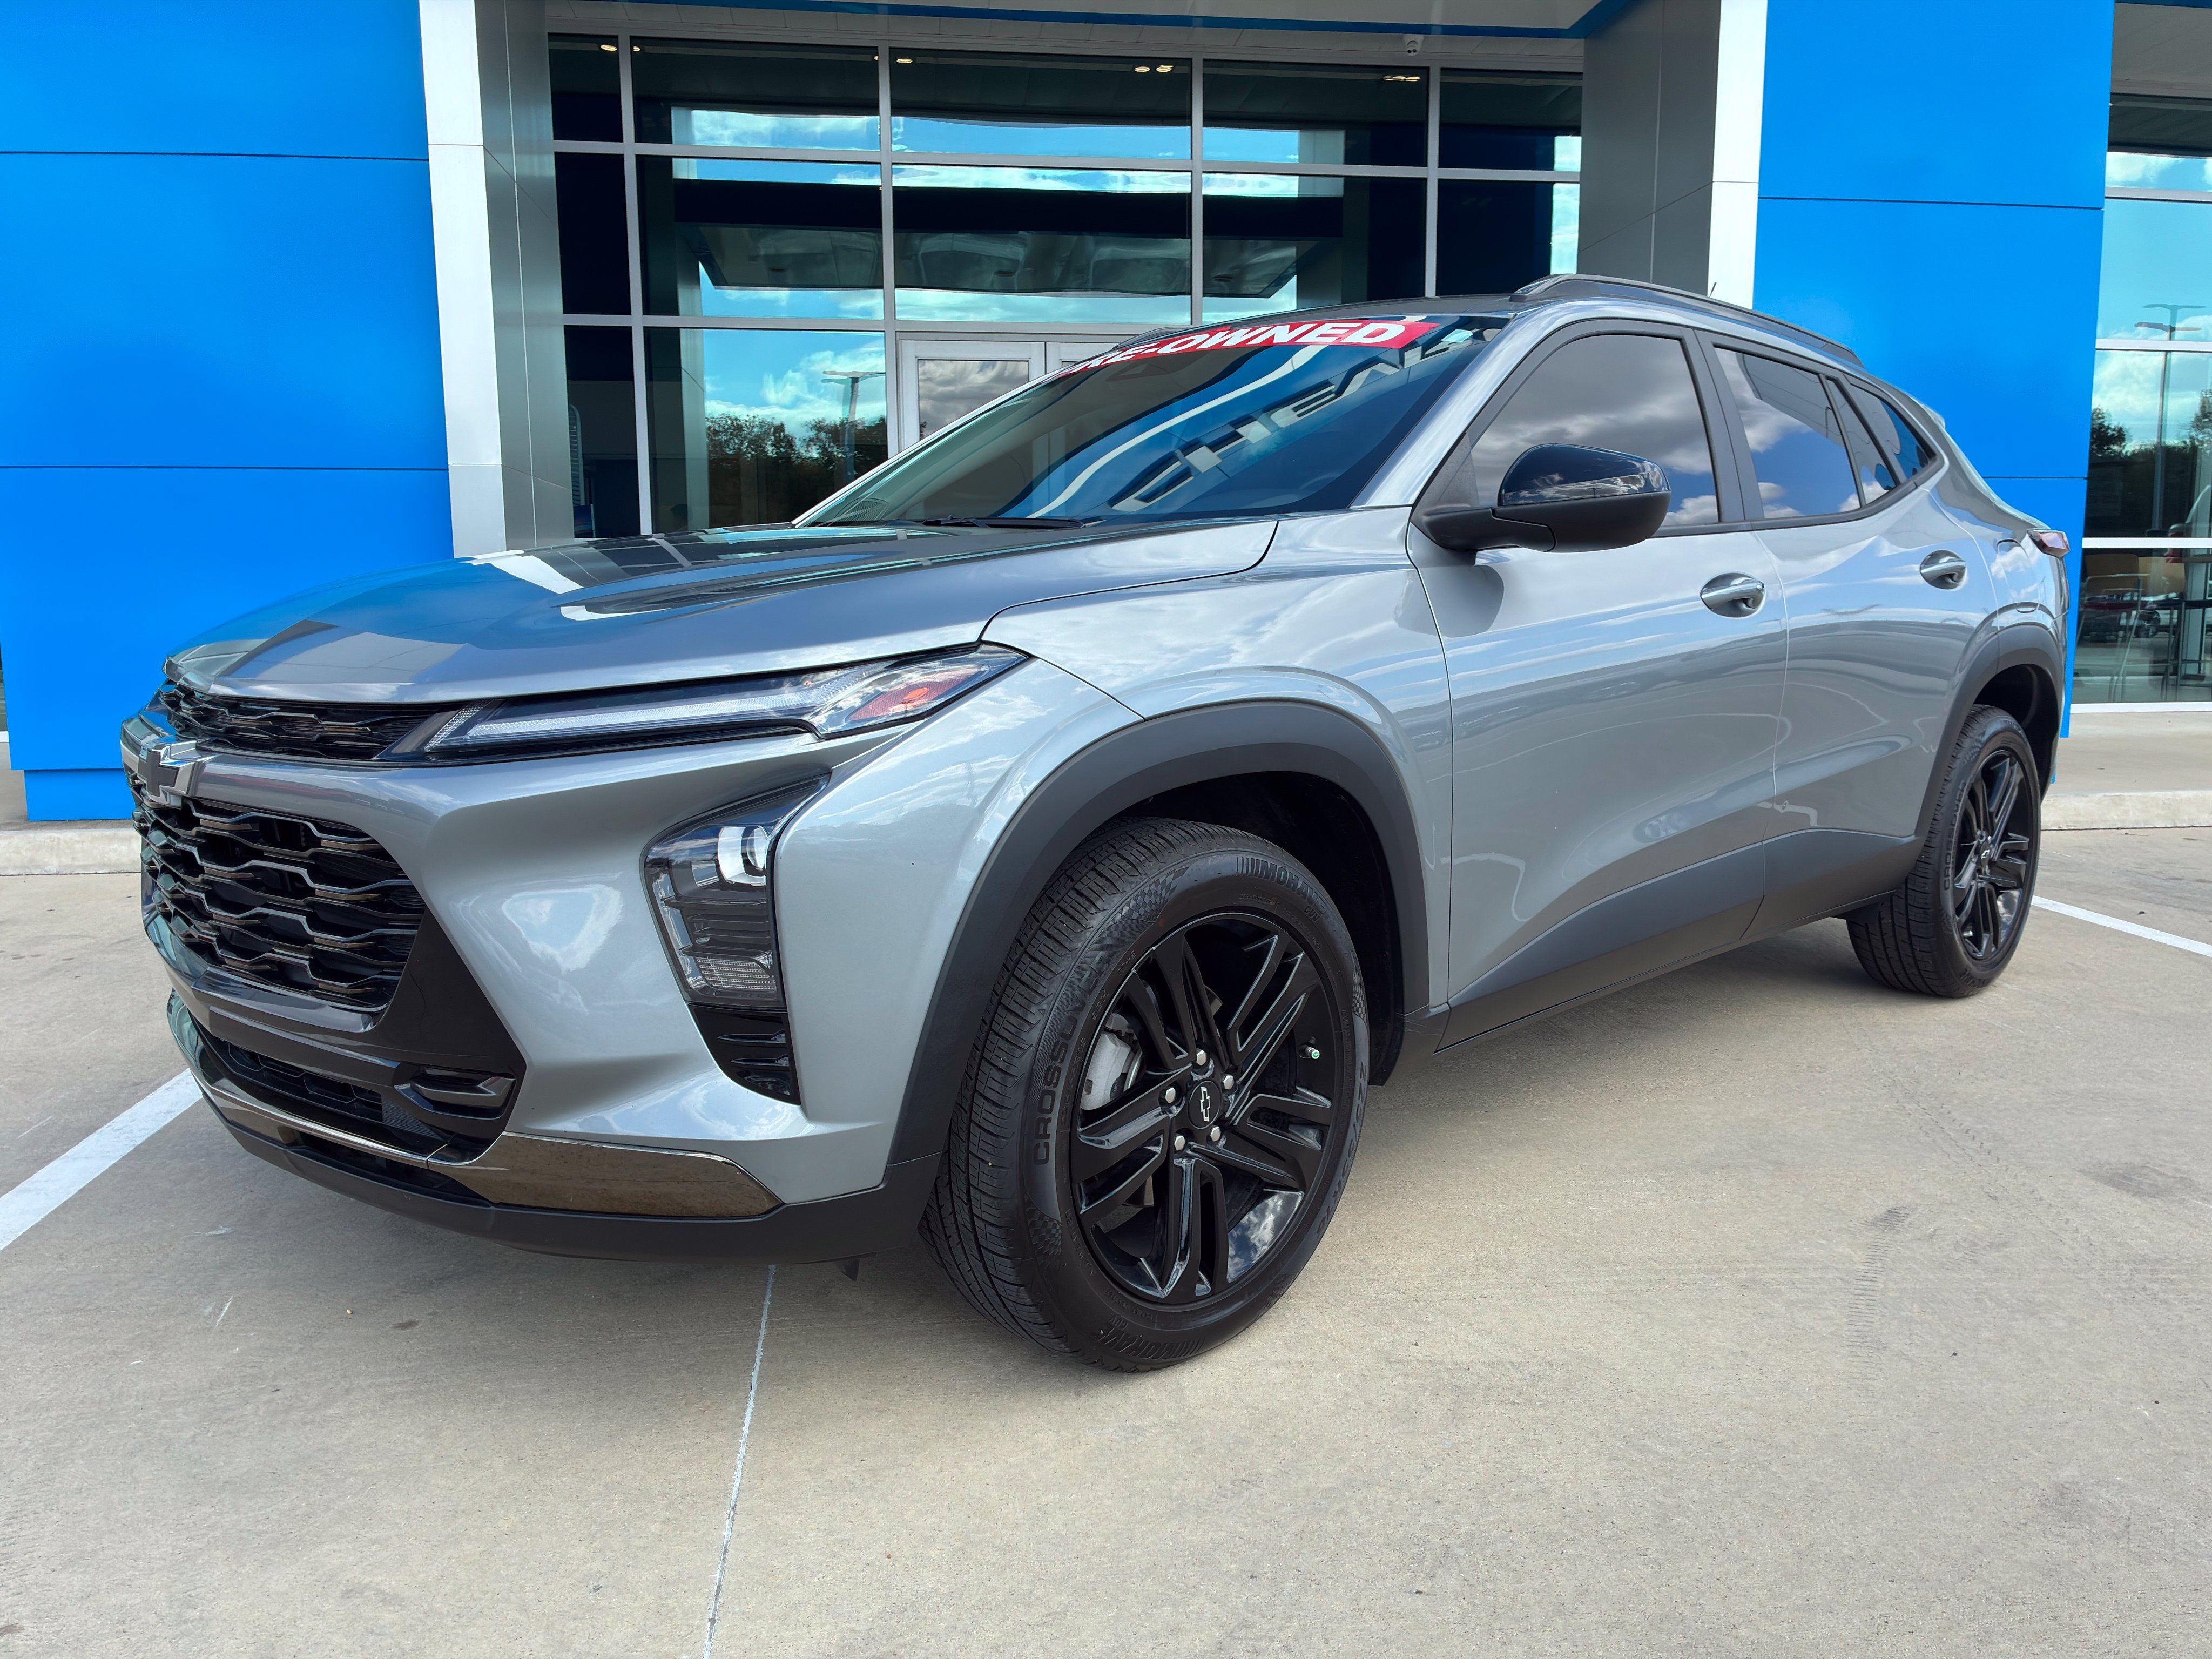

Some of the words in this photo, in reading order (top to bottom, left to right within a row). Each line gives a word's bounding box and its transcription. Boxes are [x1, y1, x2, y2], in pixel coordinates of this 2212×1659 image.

[1259, 860, 1327, 916] MOHAVE
[1304, 905, 1320, 923] CUV
[1032, 950, 1112, 1166] CROSSOVER
